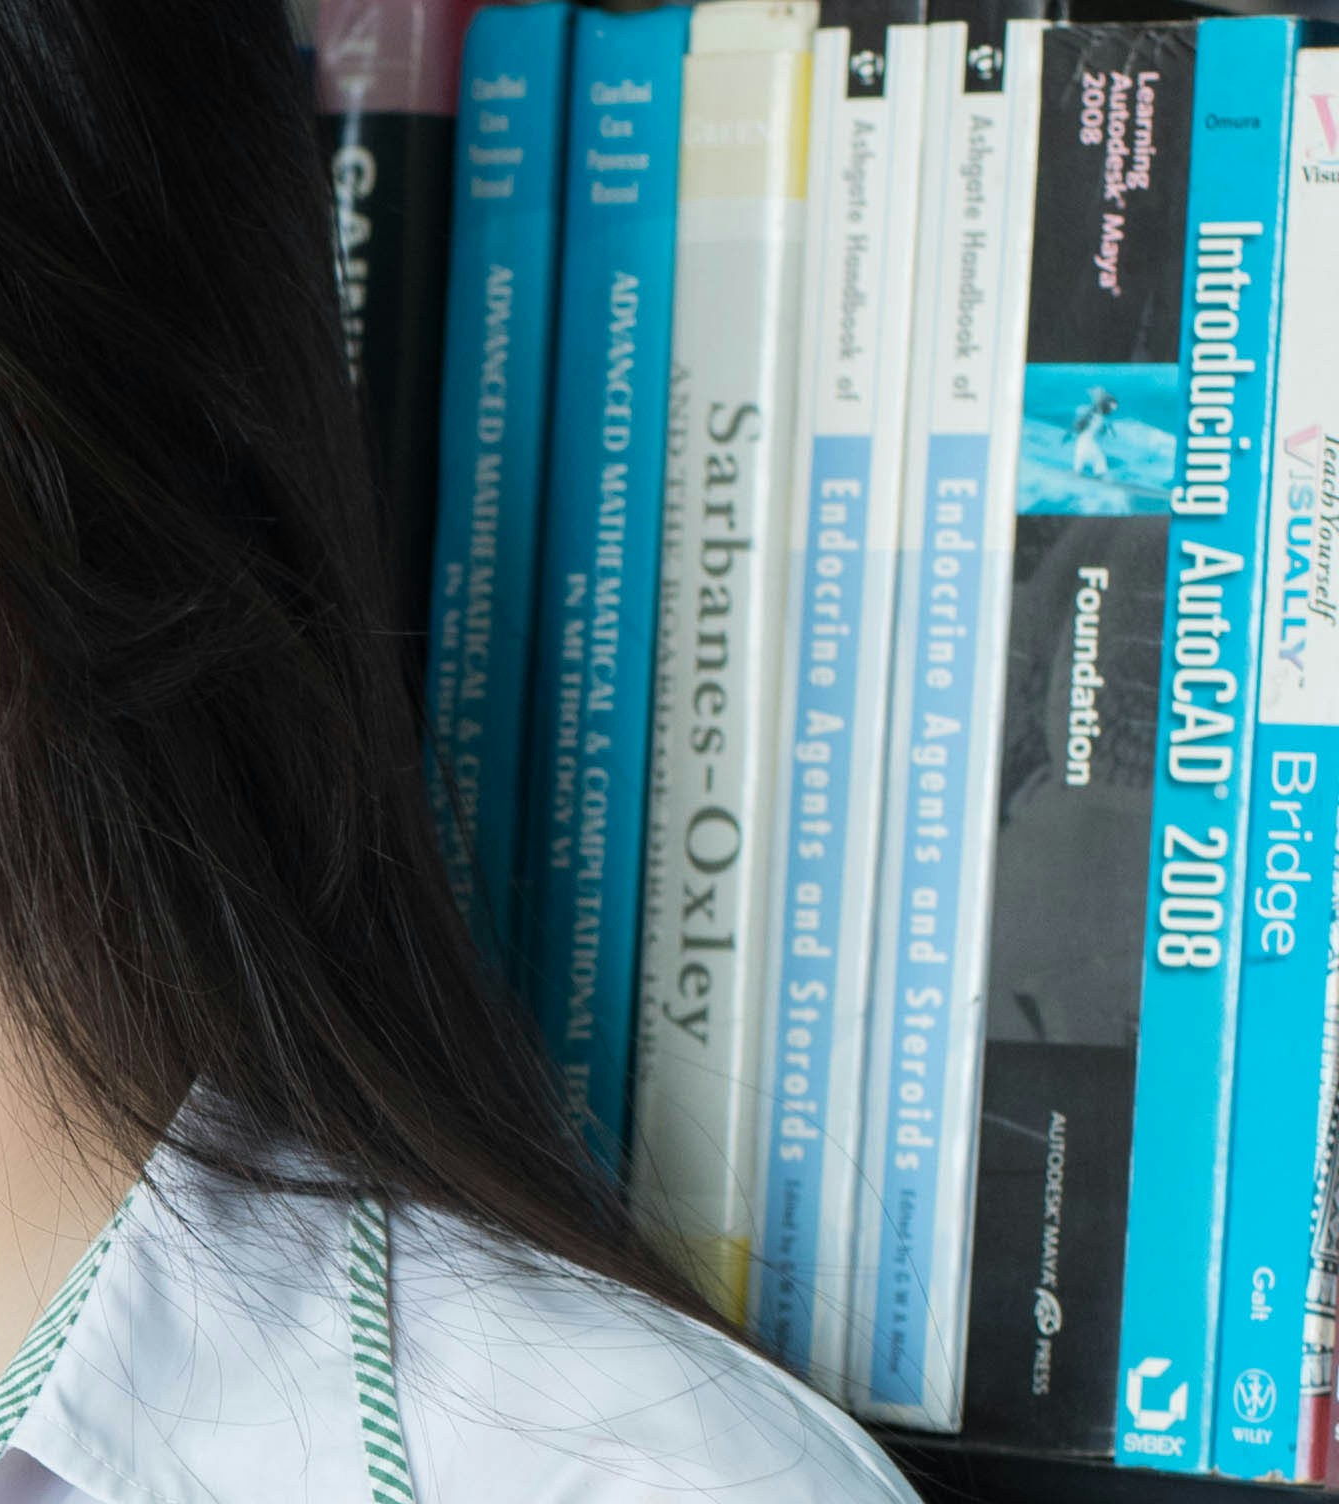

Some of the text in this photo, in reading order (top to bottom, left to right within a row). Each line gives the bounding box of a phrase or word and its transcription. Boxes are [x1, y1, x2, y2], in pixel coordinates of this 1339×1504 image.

[1079, 70, 1160, 295] Learning Autodesk Maya 2008
[1205, 113, 1261, 132] Omura
[836, 120, 876, 403] Ashgate Handbook of
[952, 115, 992, 403] Ashgate Handbook of
[478, 264, 513, 444] ADVANCED
[603, 270, 639, 452] ADVANCED
[1171, 221, 1264, 516] Introducing
[459, 453, 504, 702] MATHEMATICAL
[586, 463, 629, 714] MATHEMATICAL
[924, 478, 978, 693] Endocrine
[1310, 525, 1338, 627] Yourself
[584, 730, 610, 754] &
[664, 400, 764, 1047] Sarbanes-Oxley
[1066, 566, 1108, 787] Foundation
[778, 478, 862, 1165] Endocrine Agents and Steroids
[909, 712, 962, 864] Agents
[1255, 750, 1318, 957] Bridge
[907, 886, 948, 966] and
[1157, 824, 1228, 968] 2008
[894, 986, 942, 1174] Steroids
[1044, 1109, 1067, 1217] AUTODESK
[1033, 1337, 1053, 1396] PRESS
[1250, 1265, 1276, 1322] Galt
[1124, 1432, 1186, 1457] SYBEX
[1233, 1426, 1274, 1446] WILEY
